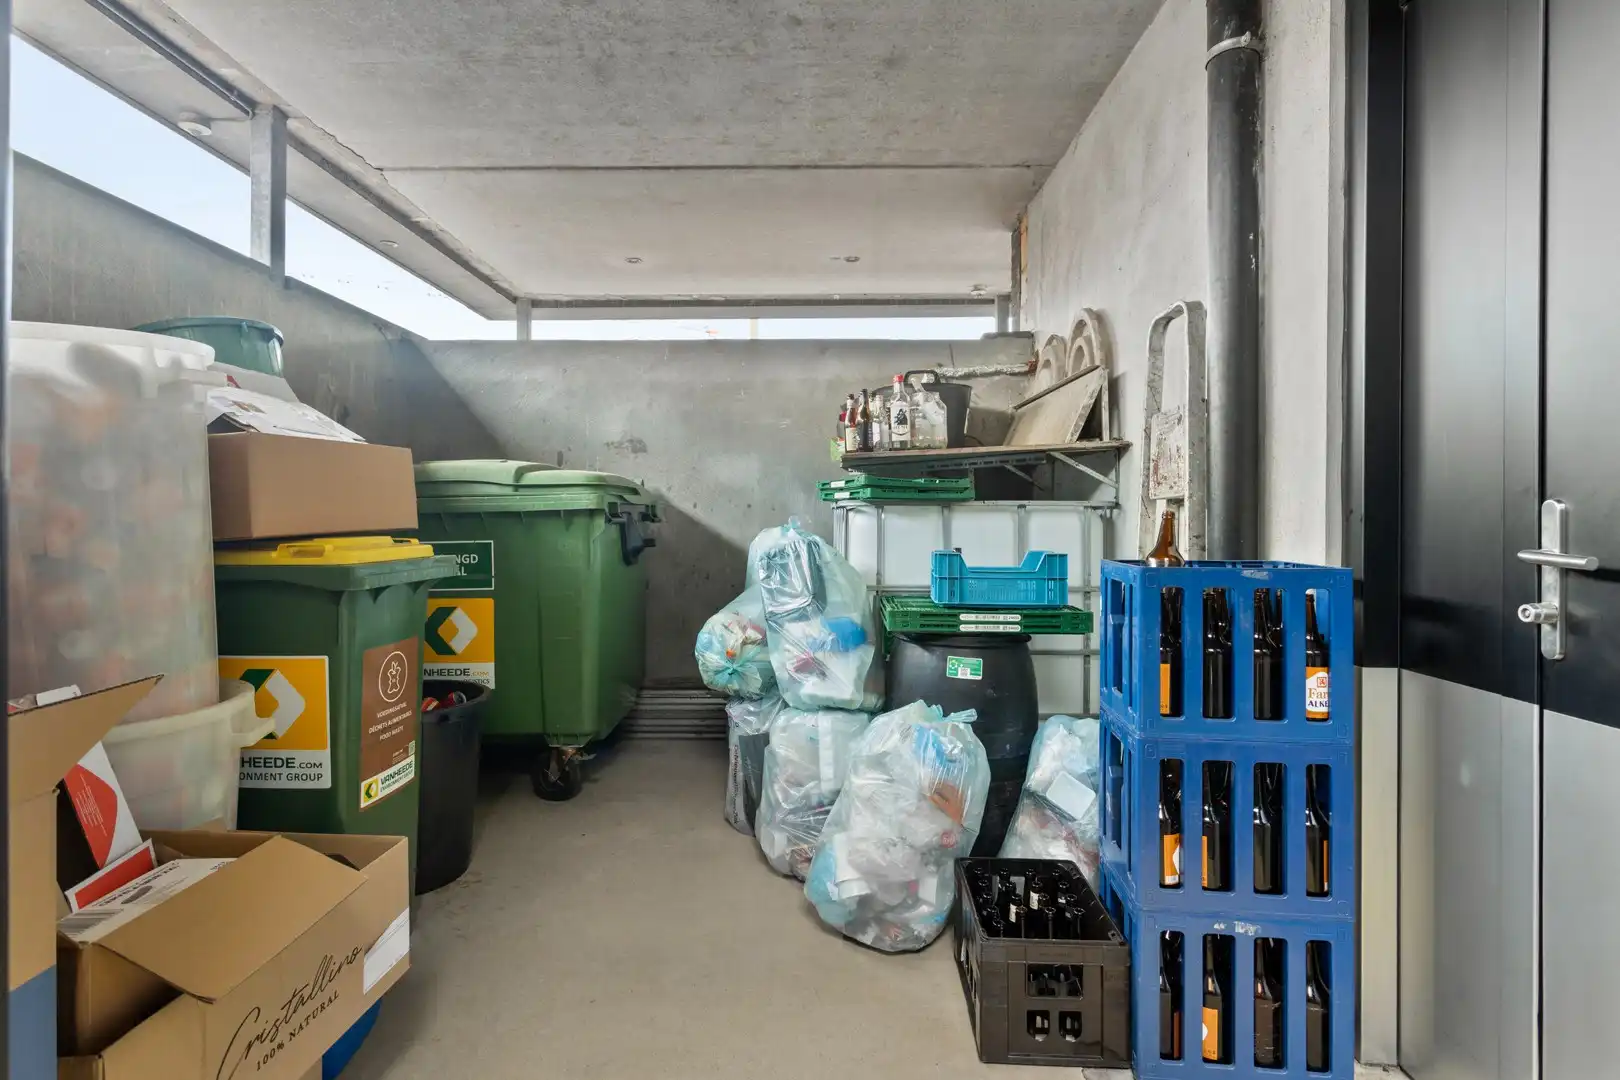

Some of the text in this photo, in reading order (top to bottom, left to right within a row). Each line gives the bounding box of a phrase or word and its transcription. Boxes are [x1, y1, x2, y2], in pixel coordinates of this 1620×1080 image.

[286, 772, 323, 781] GROUP
[381, 760, 413, 785] VANHEEDE
[216, 943, 363, 1080] Cristallino
[256, 989, 340, 1071] 100% NATURAL
